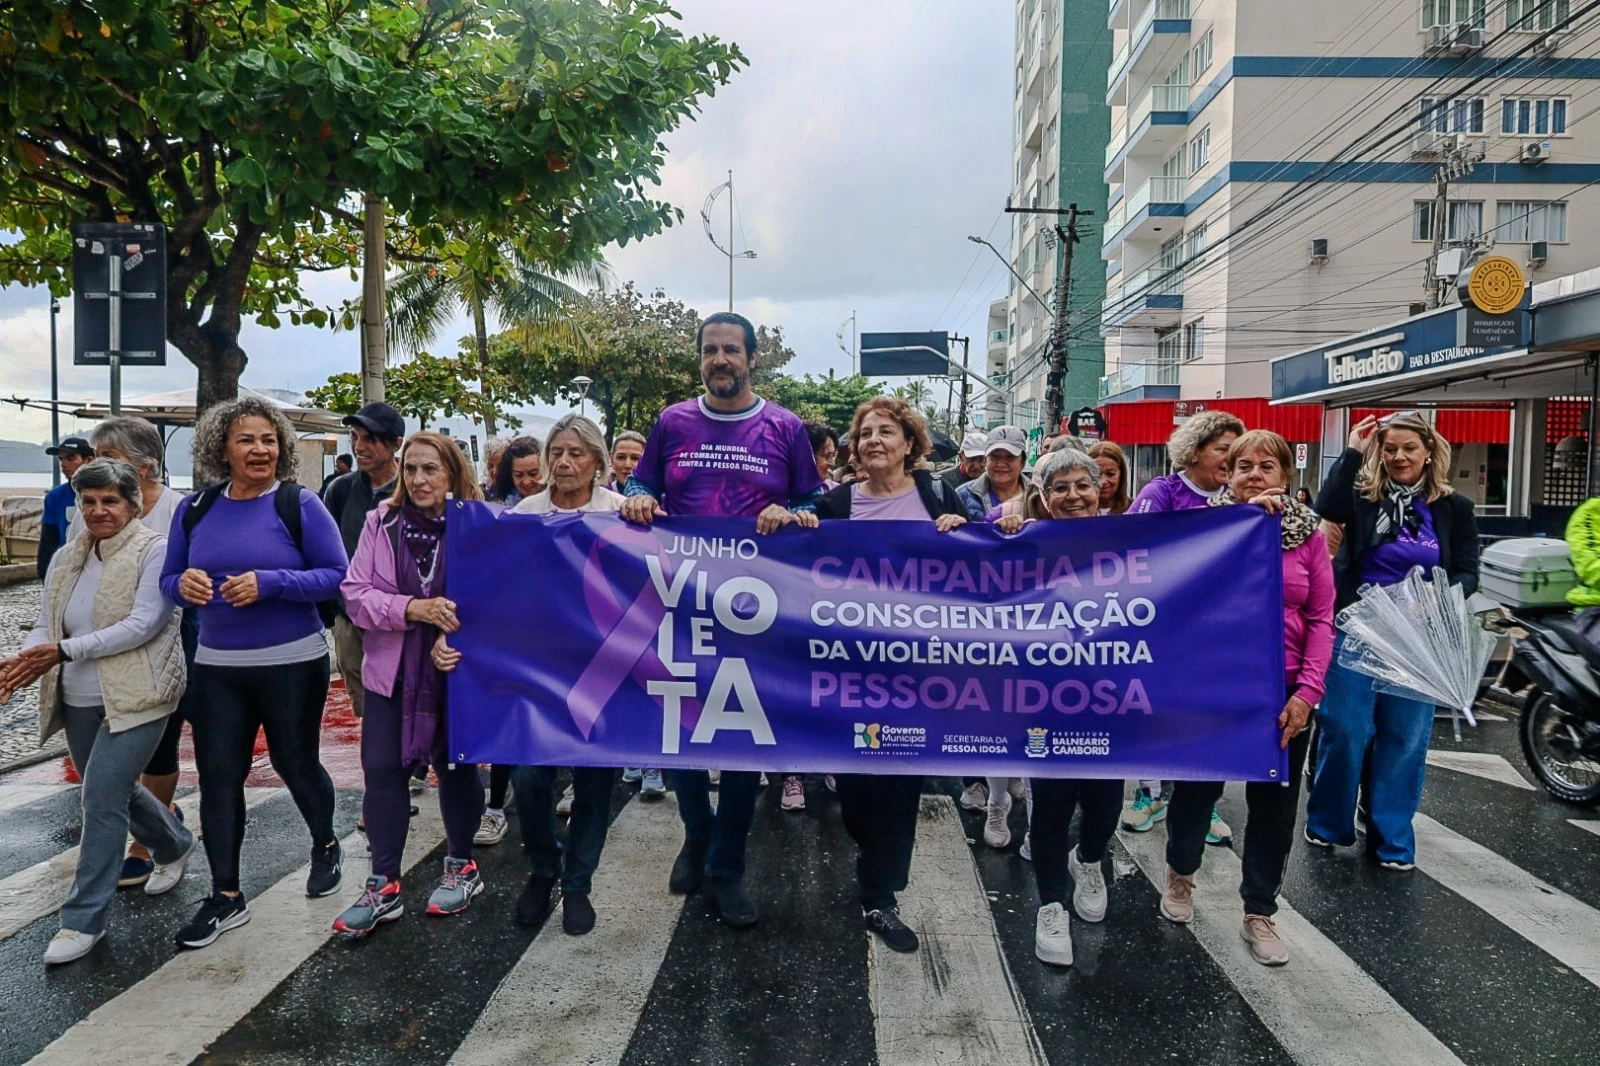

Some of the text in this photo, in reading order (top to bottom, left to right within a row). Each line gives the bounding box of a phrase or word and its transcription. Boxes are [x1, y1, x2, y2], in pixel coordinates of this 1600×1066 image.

[1324, 332, 1405, 384] Telhadão
[1409, 354, 1424, 369] BAR
[715, 444, 748, 453] MUNDIAL
[690, 452, 722, 460] COMBATE
[732, 454, 768, 466] VIOLÊNCIA
[713, 461, 740, 470] PESSOA
[665, 536, 759, 560] JUNHO
[811, 549, 1153, 593] CAMPANHA DE
[810, 592, 1156, 636] CONSCIENTIZAÇÃO
[809, 635, 1154, 666] DA VIOLÊNCIA CONTRA
[810, 671, 1154, 715] PESSOA IDOSA
[881, 725, 926, 734] Governo
[881, 734, 926, 743] Municipal
[943, 734, 1008, 744] SECRETARIA DA
[941, 744, 1008, 754] PESSOA IDOSA
